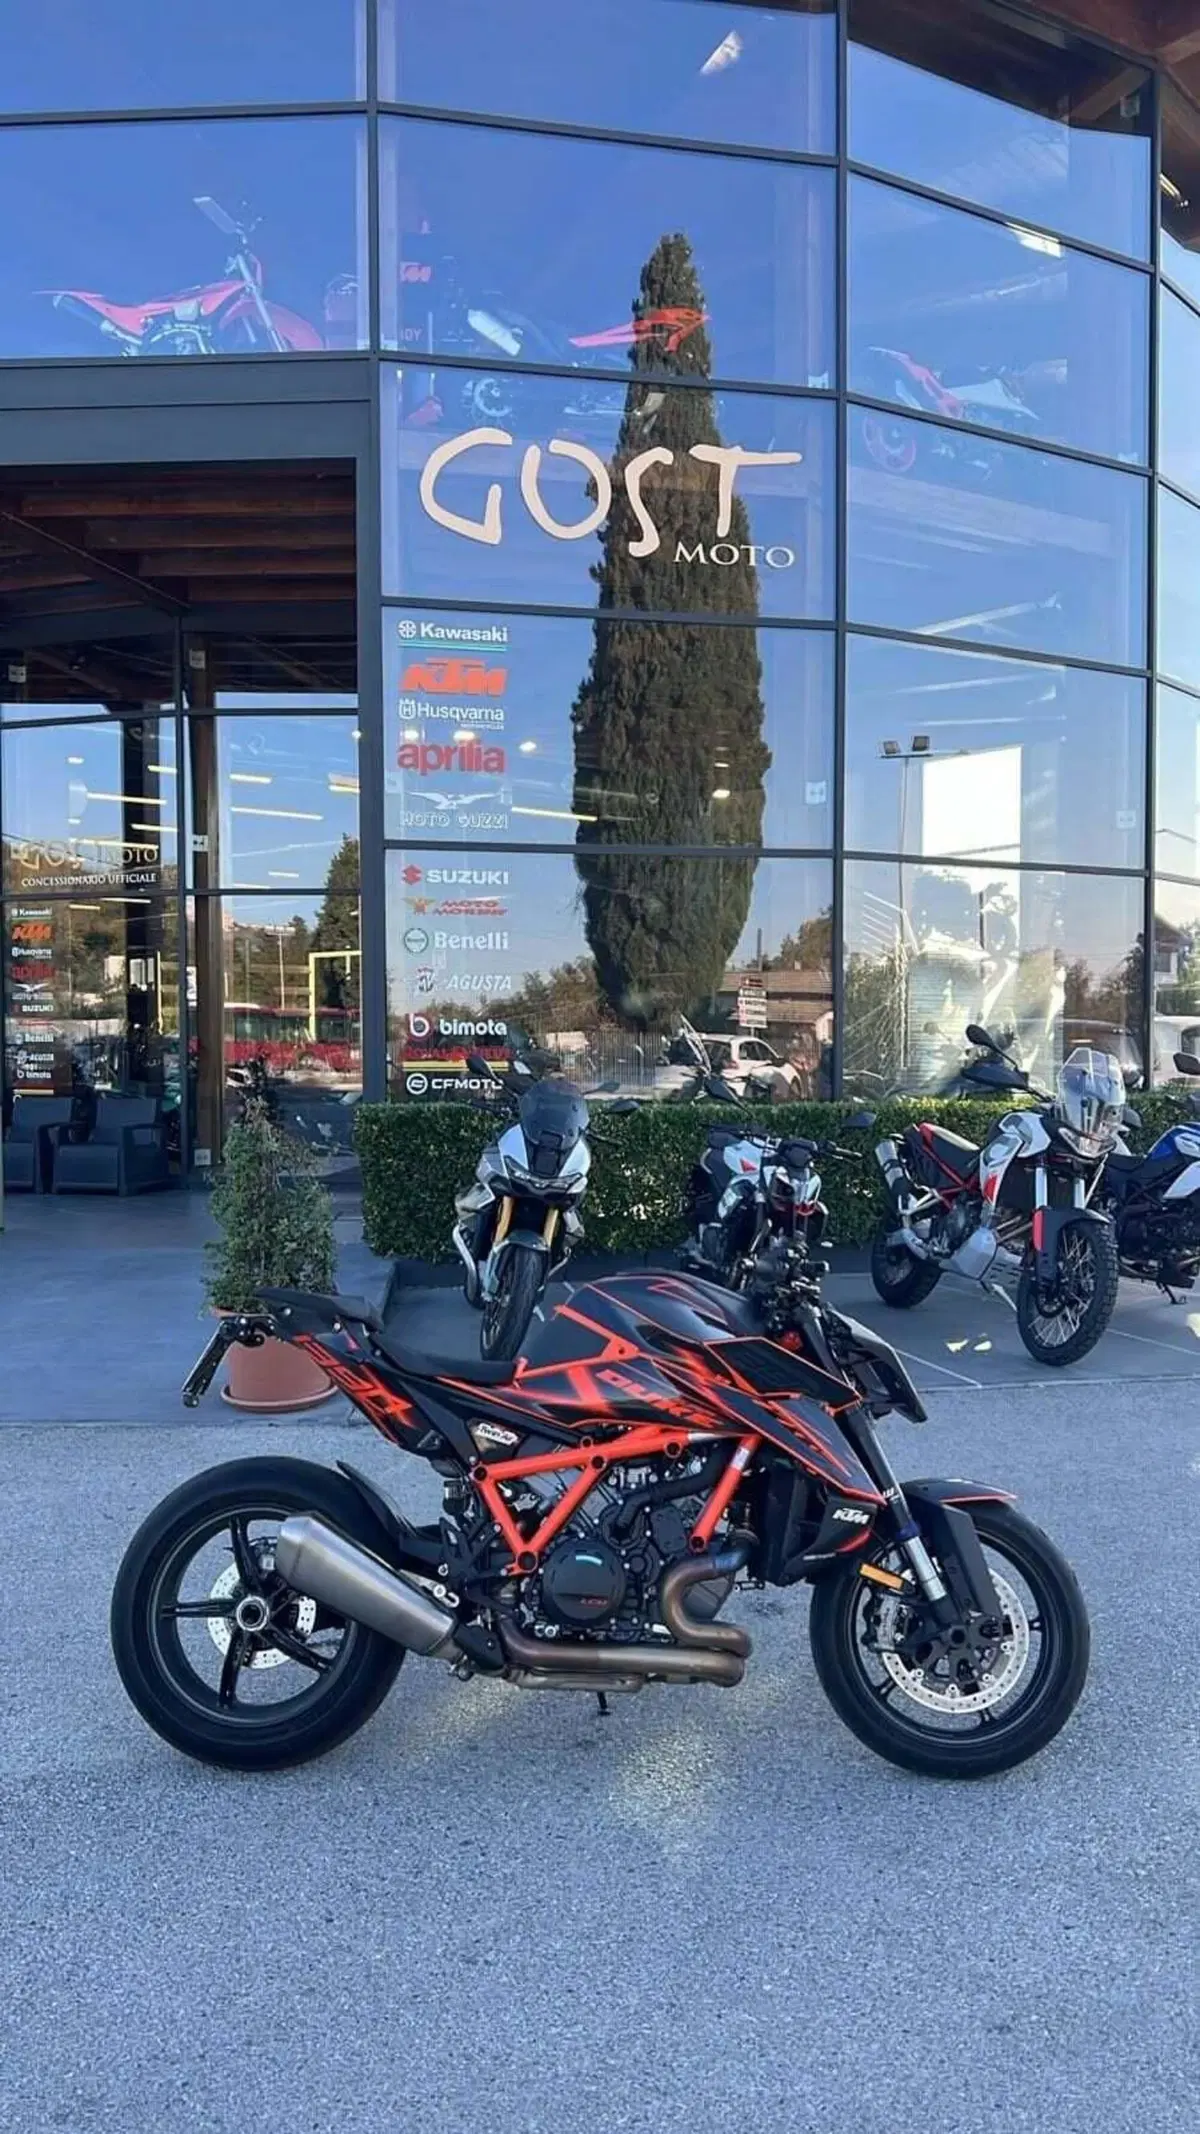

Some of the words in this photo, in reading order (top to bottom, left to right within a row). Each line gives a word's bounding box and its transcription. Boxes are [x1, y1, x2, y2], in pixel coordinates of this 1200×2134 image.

[420, 427, 802, 558] GOST
[674, 543, 795, 568] MOTO
[420, 621, 508, 643] Kawasaki
[399, 657, 508, 697] KTM
[417, 702, 505, 722] Husqvarna
[397, 741, 505, 776] aprilia
[108, 872, 157, 885] UFFICIALE
[426, 869, 509, 885] SUZUKI
[434, 931, 509, 951] Benelli
[445, 974, 512, 992] AGUSTA
[440, 1018, 508, 1037] bimota
[431, 1078, 504, 1091] CFMOTO
[832, 1507, 870, 1525] KTM
